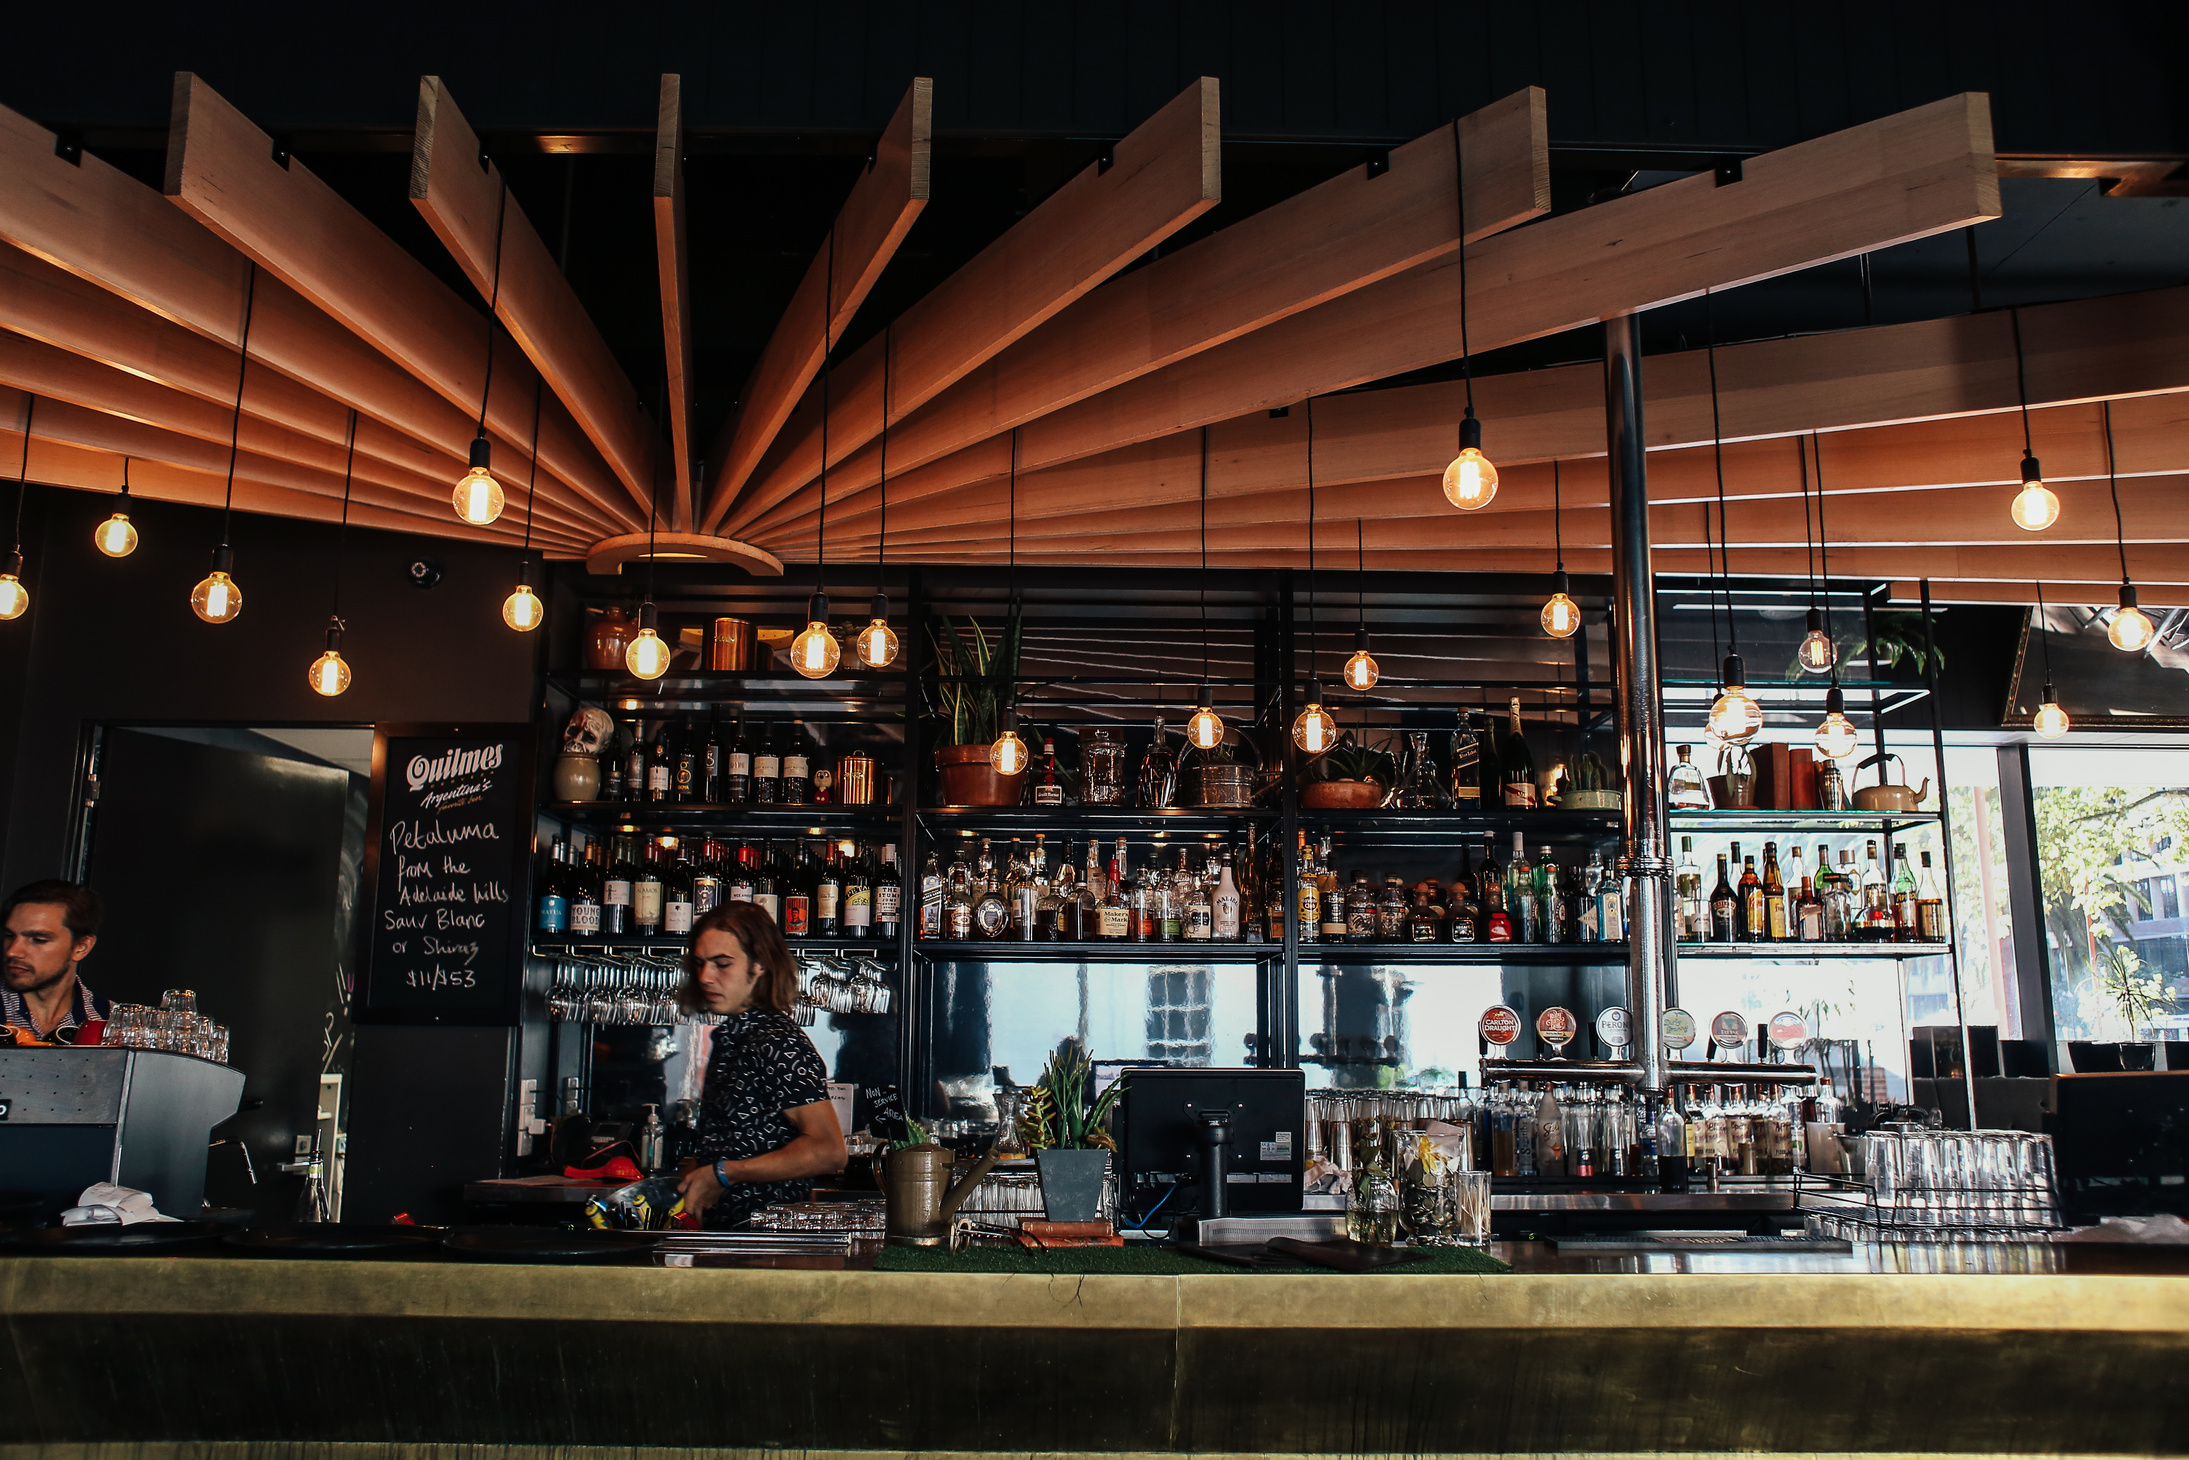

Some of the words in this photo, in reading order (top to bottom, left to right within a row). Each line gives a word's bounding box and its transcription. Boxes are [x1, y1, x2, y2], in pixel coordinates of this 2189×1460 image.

[406, 743, 504, 792] Quilmes
[419, 778, 493, 809] Argentina's
[389, 819, 500, 855] Petaluma
[442, 855, 471, 874] the
[399, 882, 467, 907] Adelaide
[384, 910, 428, 930] Sauv
[436, 908, 486, 930] Blanc
[571, 906, 600, 915] YOUNG
[392, 940, 408, 953] or
[883, 1106, 904, 1122] AREA
